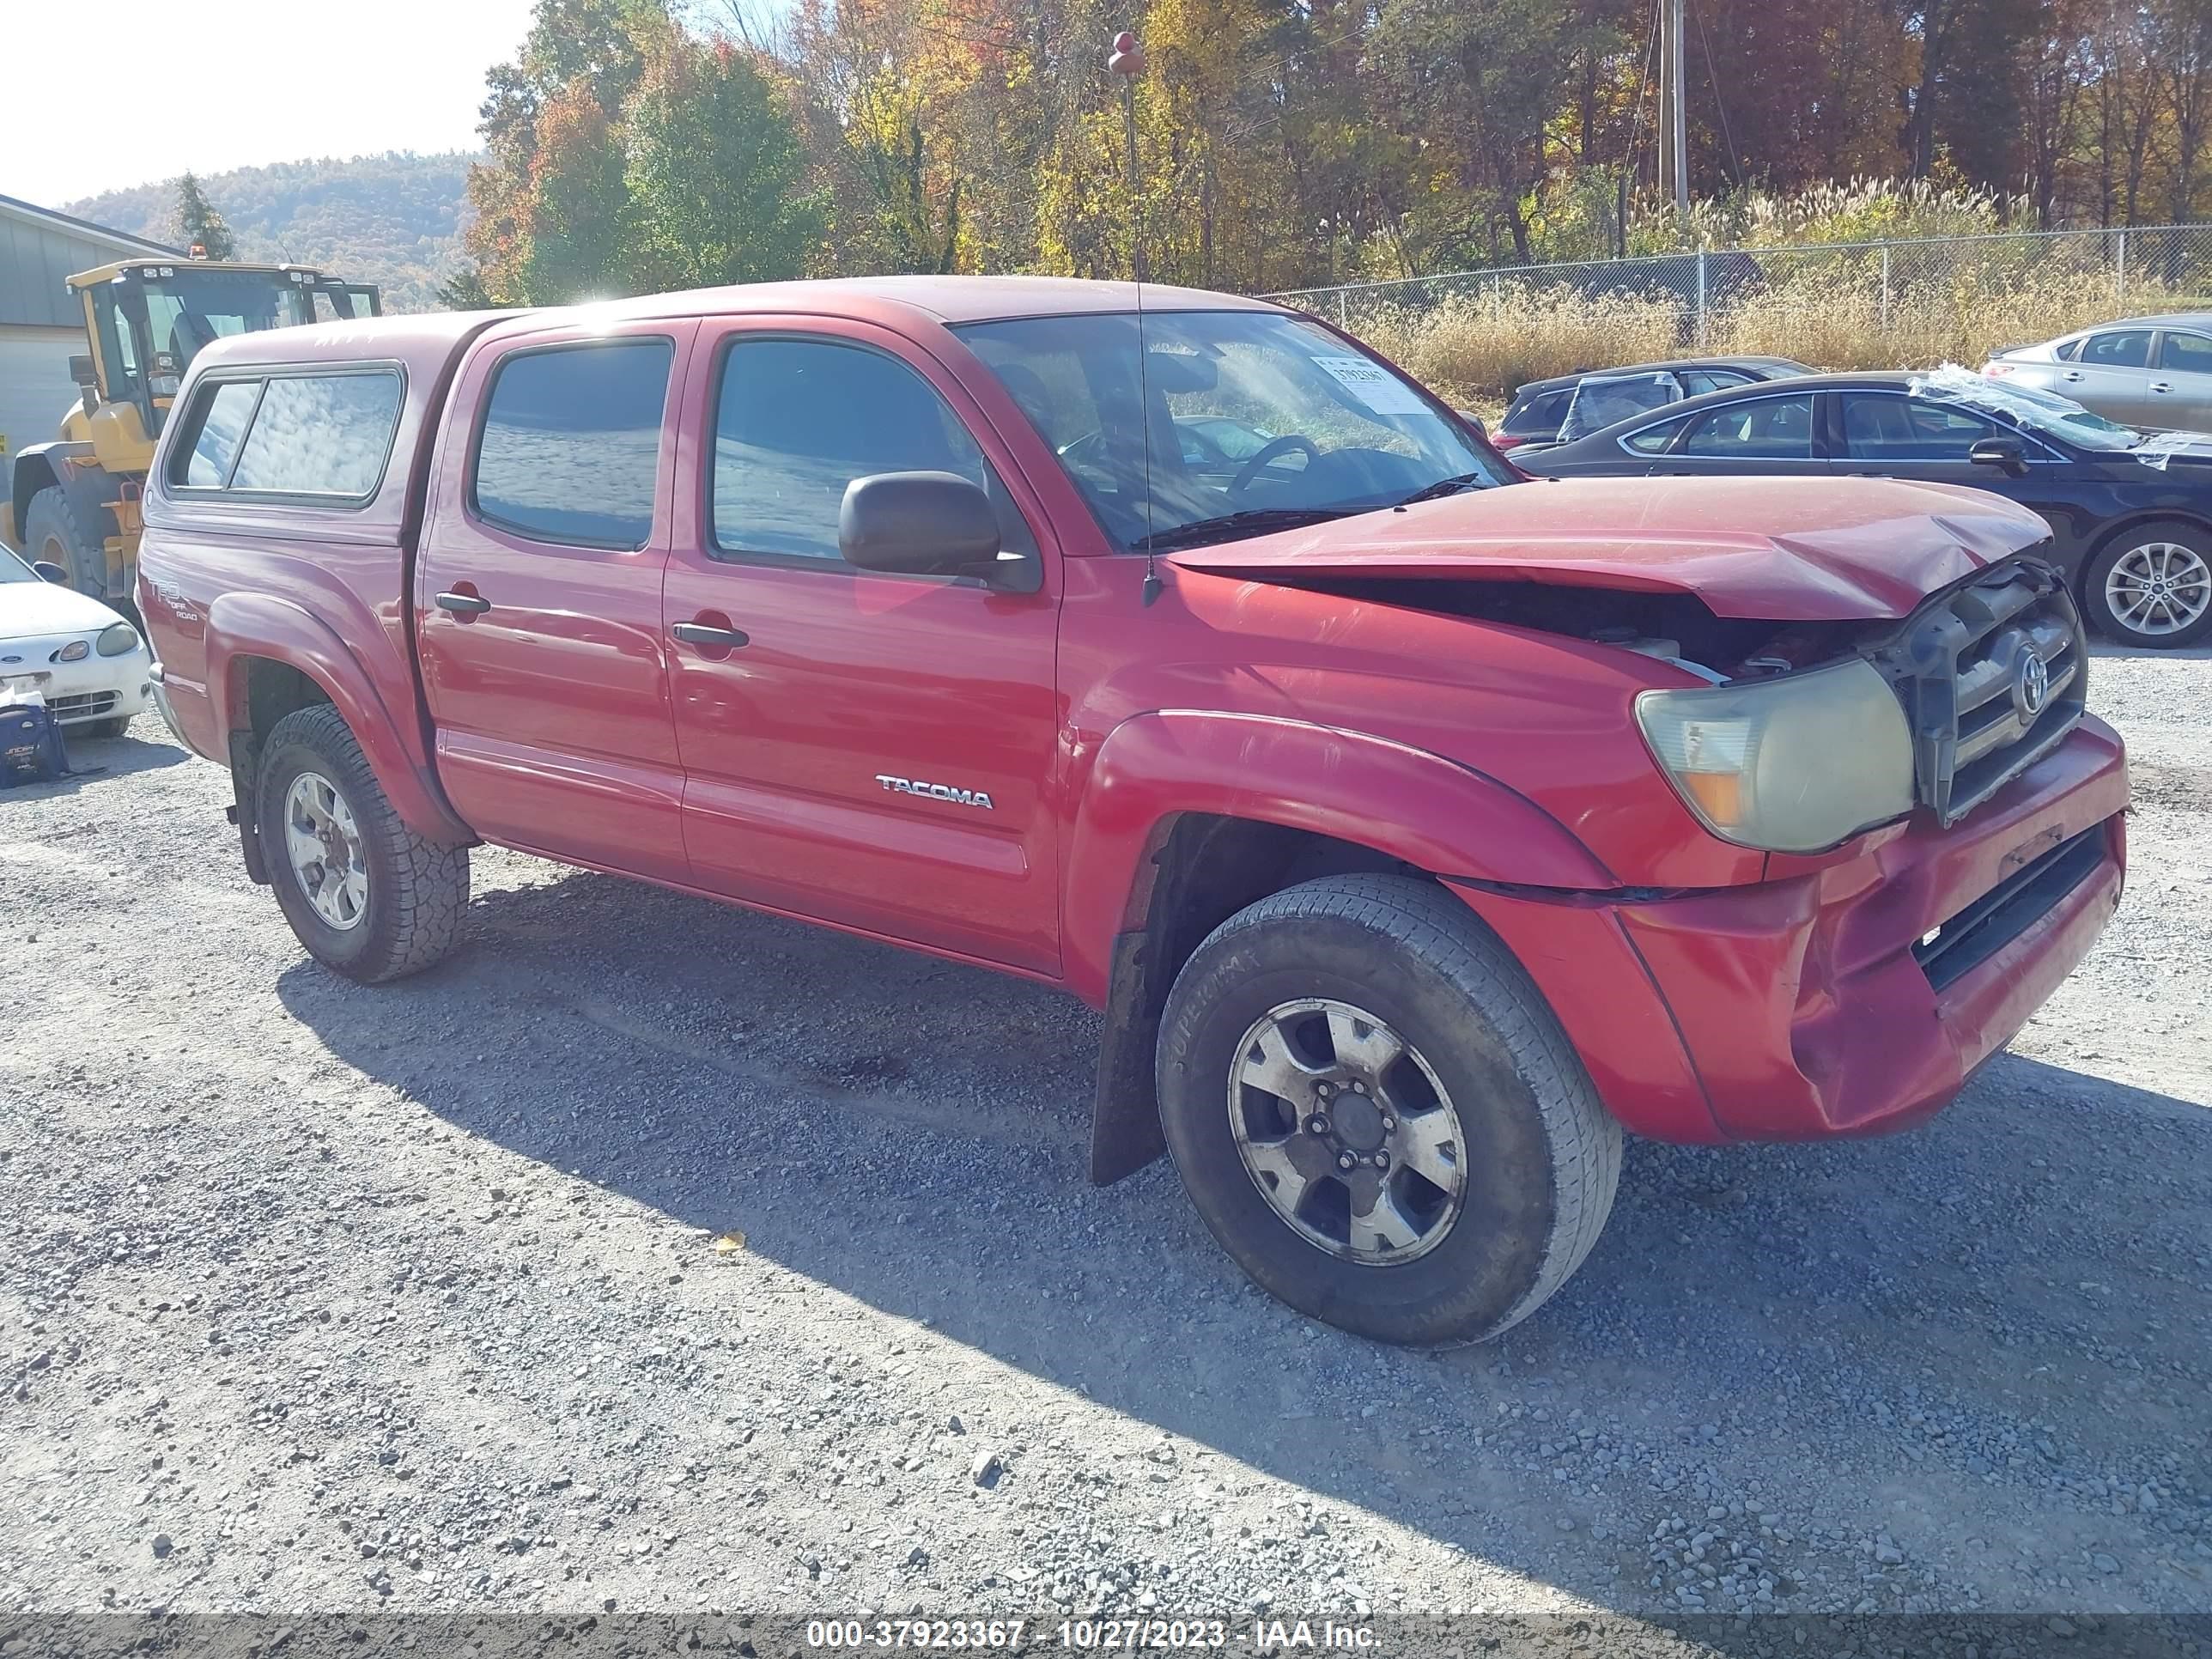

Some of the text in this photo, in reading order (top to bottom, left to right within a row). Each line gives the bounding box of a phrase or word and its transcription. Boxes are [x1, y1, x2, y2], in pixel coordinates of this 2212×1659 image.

[1334, 369, 1388, 381] 37923367
[148, 578, 180, 603] TRD
[176, 611, 198, 621] ROAD
[875, 775, 994, 810] TACOMA
